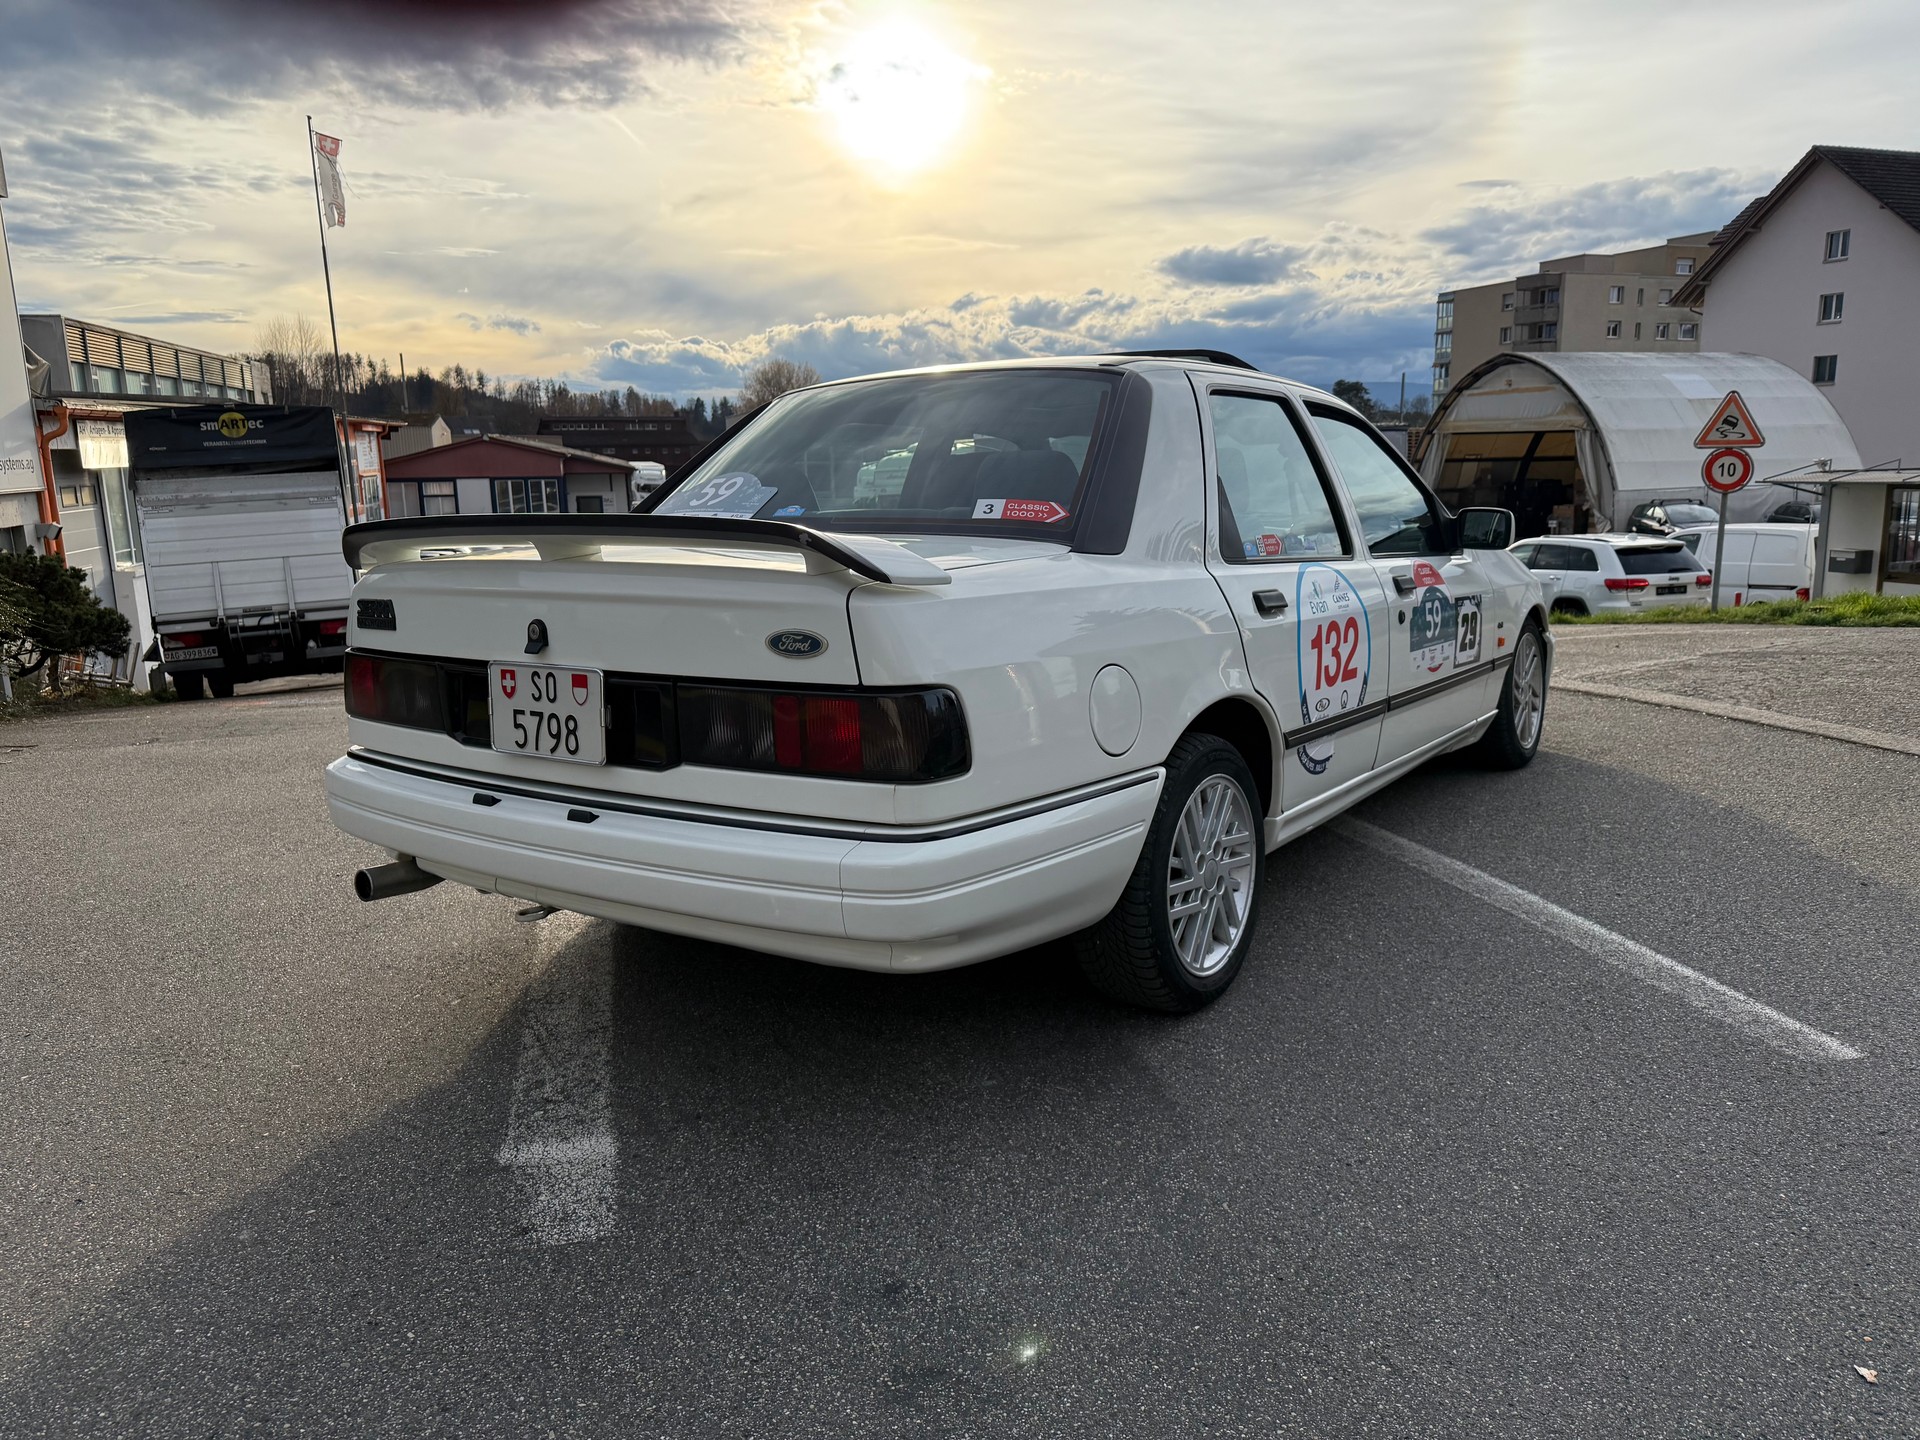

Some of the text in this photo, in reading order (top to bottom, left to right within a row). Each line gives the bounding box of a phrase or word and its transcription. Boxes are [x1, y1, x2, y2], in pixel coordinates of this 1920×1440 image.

[200, 418, 264, 431] smARTec
[1718, 462, 1736, 477] 10
[689, 477, 744, 506] 59
[982, 504, 995, 515] 3
[1008, 503, 1050, 512] CLASSIC
[1332, 593, 1350, 604] CANNES
[1425, 600, 1442, 639] 59
[778, 634, 811, 651] Ford
[1459, 611, 1478, 653] 29
[1311, 616, 1359, 691] 132
[531, 671, 557, 703] SO
[513, 709, 579, 755] 5798
